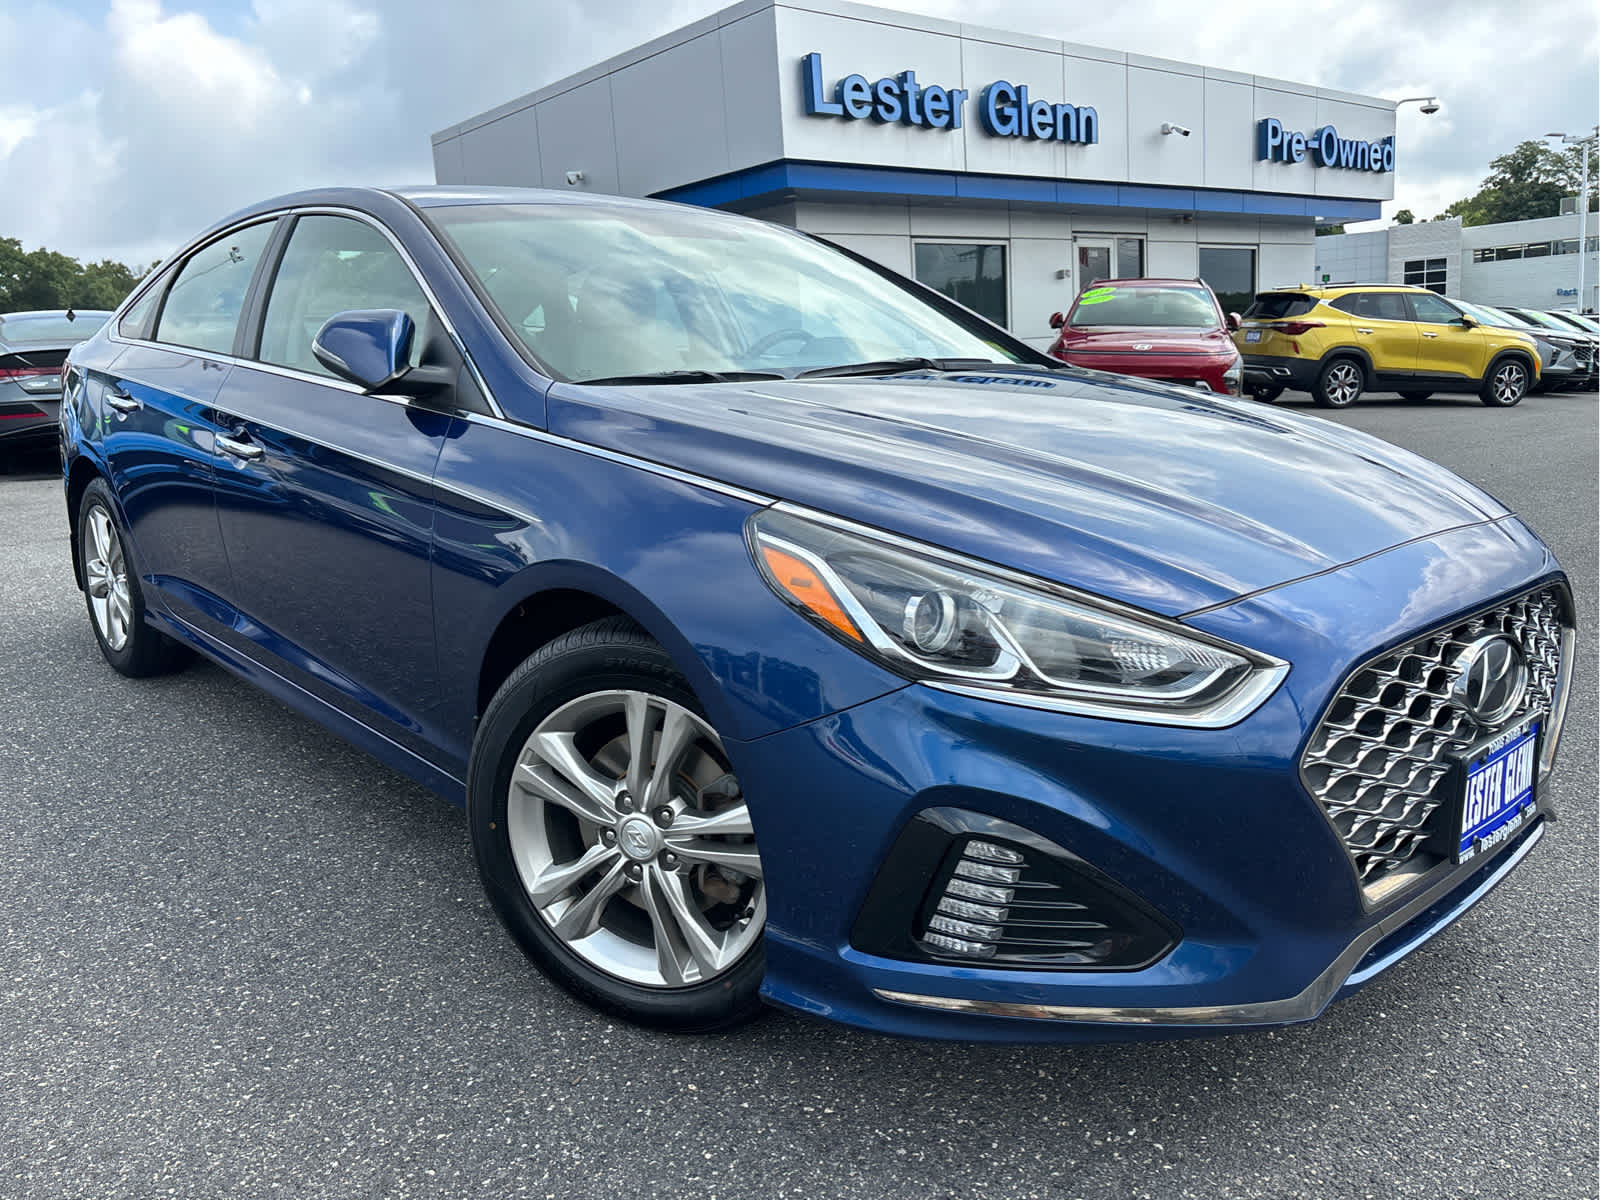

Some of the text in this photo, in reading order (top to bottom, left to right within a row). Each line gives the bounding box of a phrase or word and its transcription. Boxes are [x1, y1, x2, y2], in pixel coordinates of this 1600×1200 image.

[801, 53, 1098, 144] Lester Glenn
[1256, 118, 1395, 172] Pre-Owned
[1462, 737, 1535, 833] LESTER GLENN
